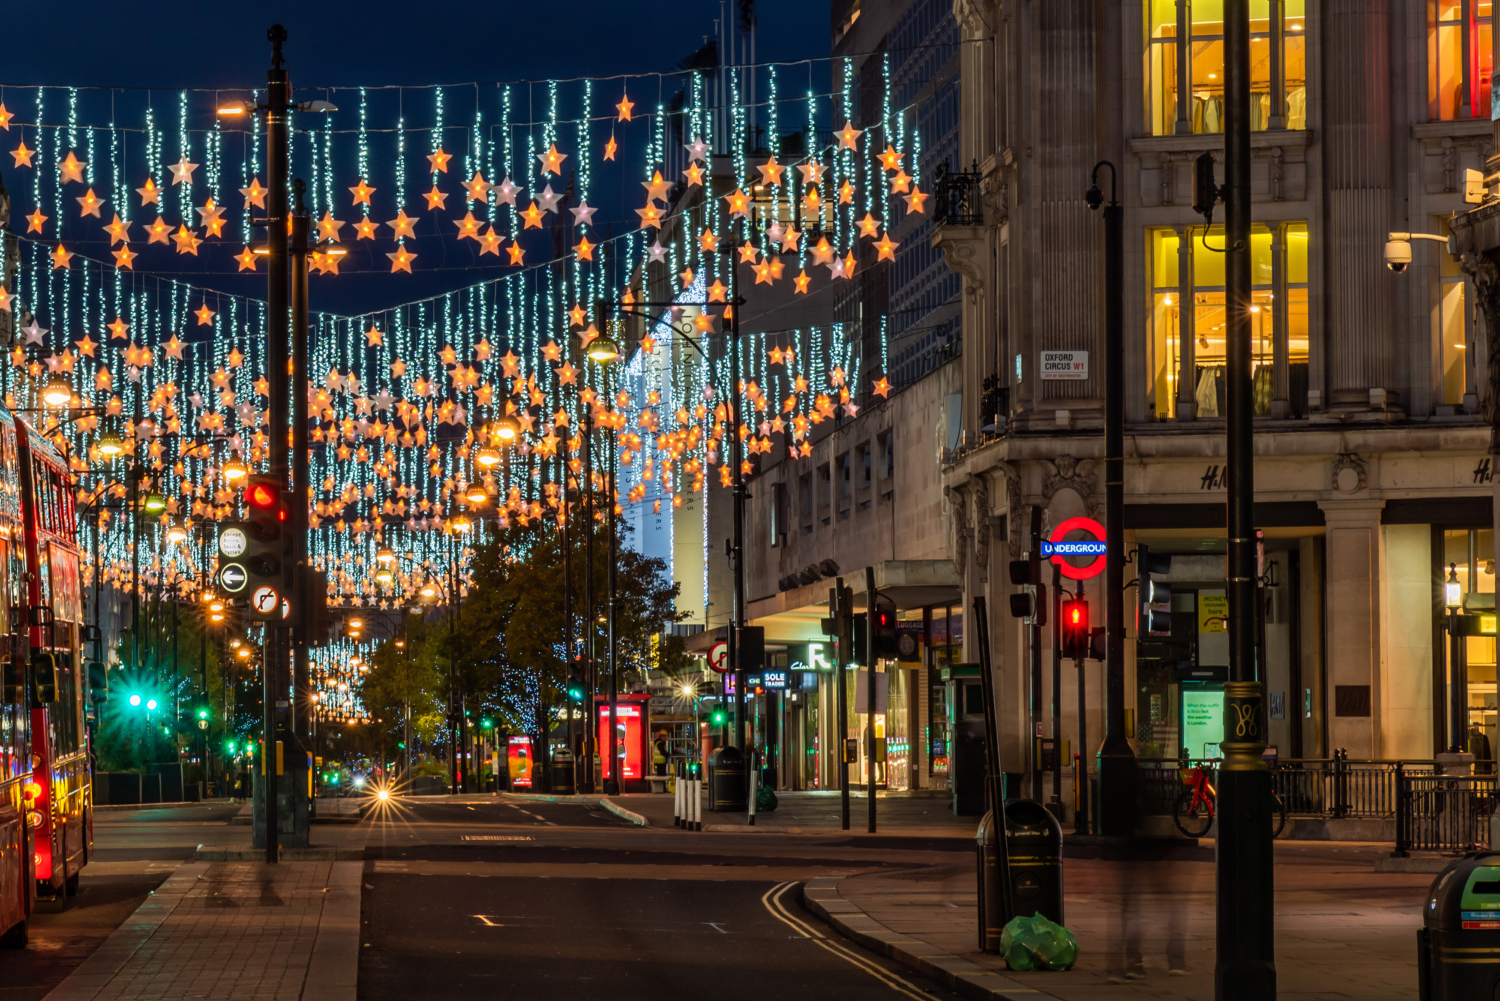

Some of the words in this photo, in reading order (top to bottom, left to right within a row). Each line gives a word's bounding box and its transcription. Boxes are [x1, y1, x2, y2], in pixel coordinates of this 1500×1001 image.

[1045, 353, 1073, 361] OXFORD
[1045, 362, 1071, 370] CIRCUS
[1473, 457, 1493, 484] H&
[1044, 544, 1107, 553] UNDERGROUN
[897, 621, 925, 629] LUGGAGE
[790, 661, 809, 670] Clar
[764, 673, 785, 681] SOLE
